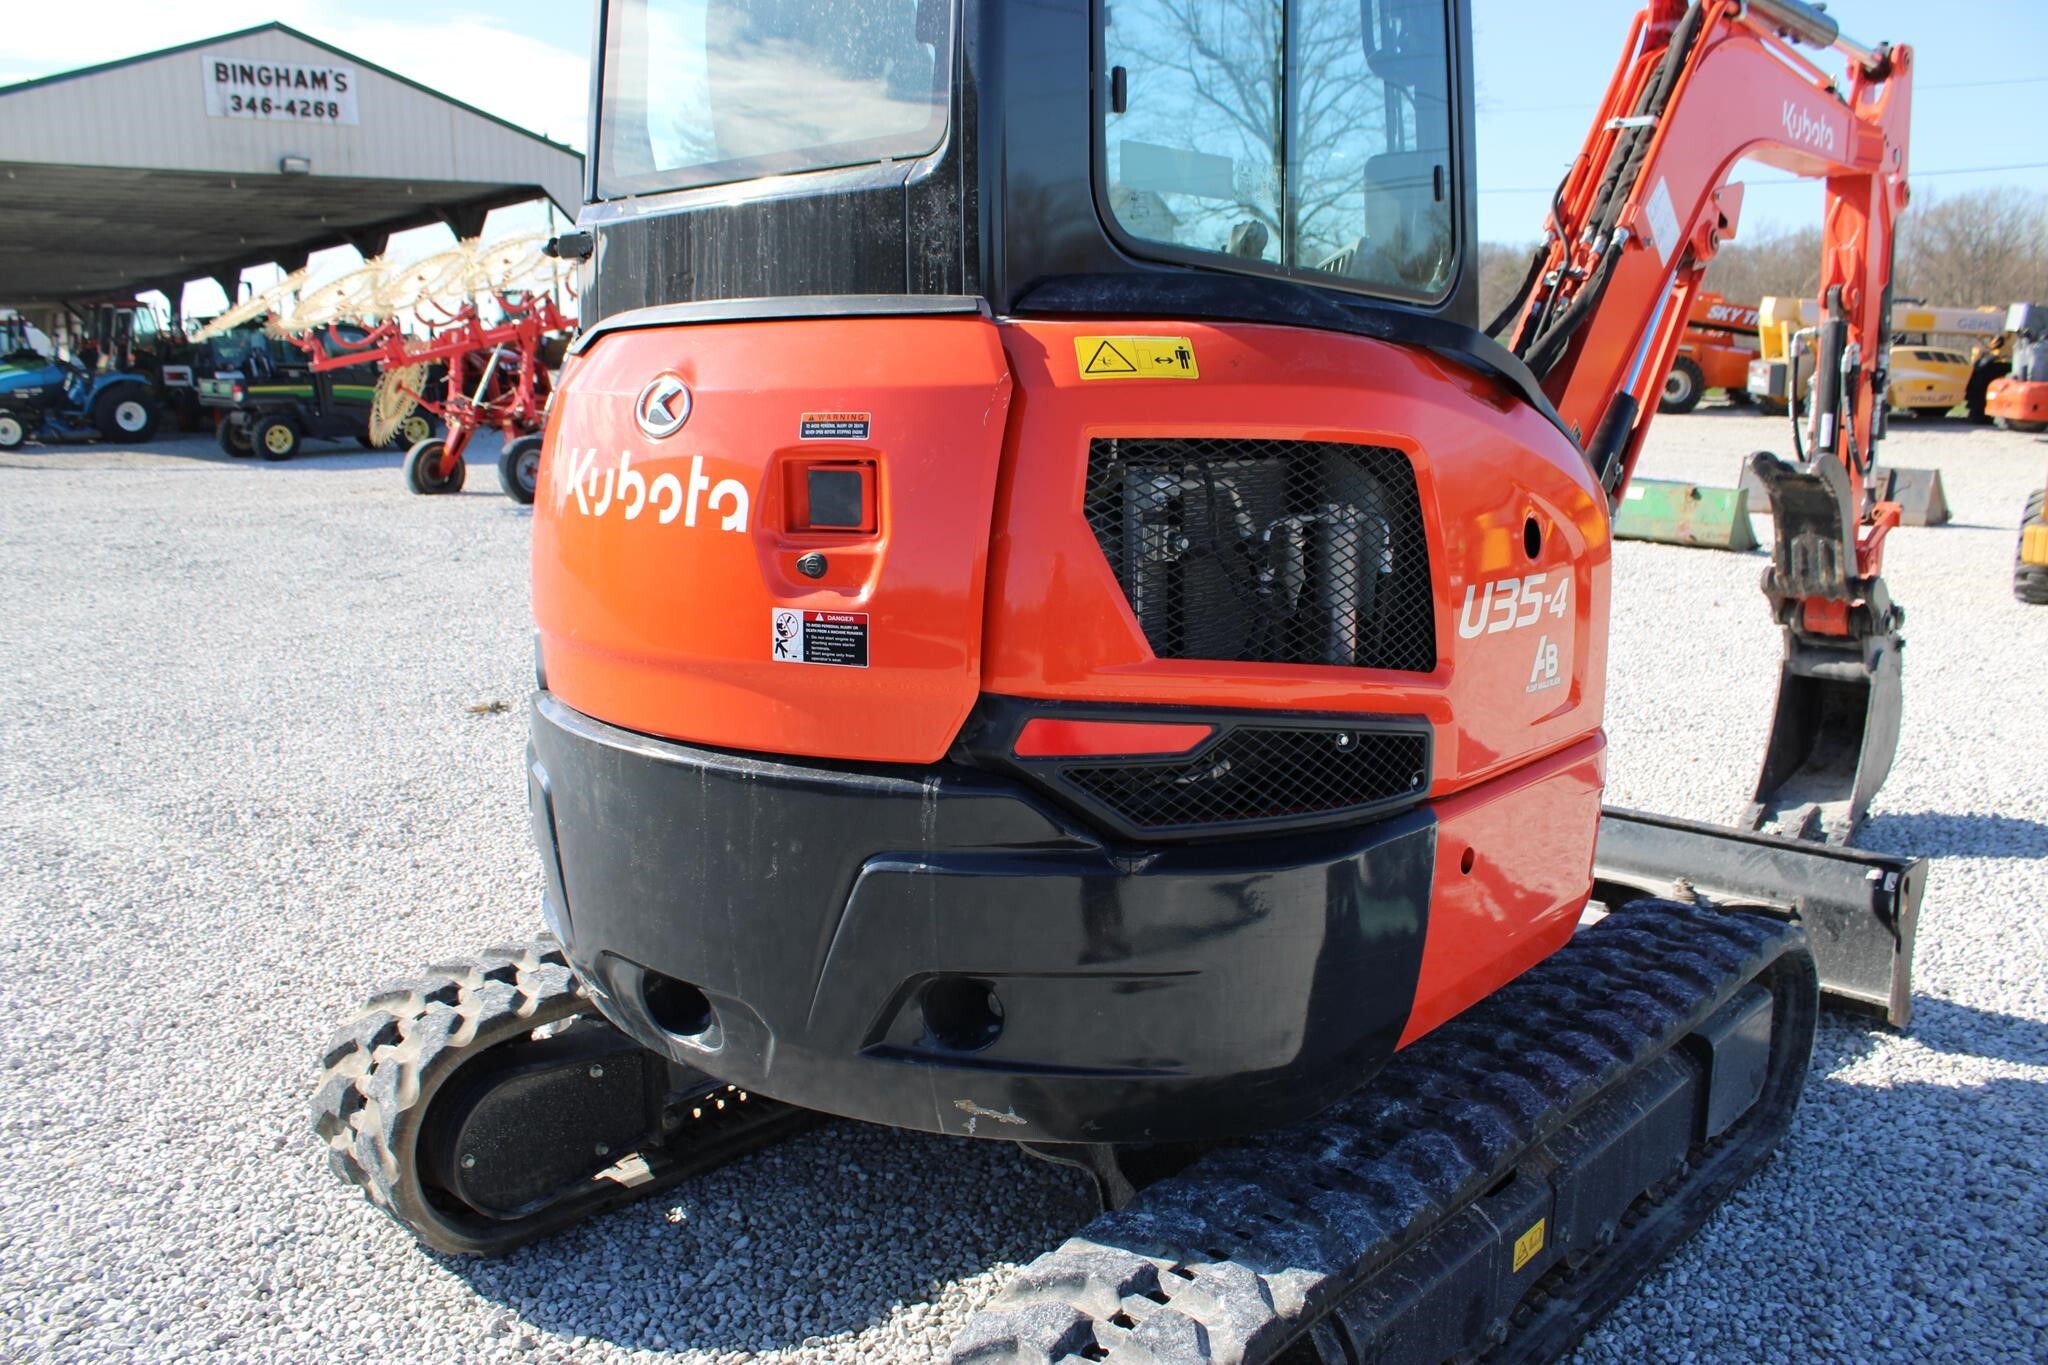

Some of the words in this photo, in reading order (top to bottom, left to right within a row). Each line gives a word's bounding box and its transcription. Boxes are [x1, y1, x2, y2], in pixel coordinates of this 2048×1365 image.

[215, 62, 348, 92] BINGHAM'S
[230, 94, 340, 118] 346-4268
[1782, 100, 1834, 150] Kubota
[1707, 304, 1743, 323] SKY
[566, 447, 750, 533] Kubota
[1458, 573, 1569, 639] U35-4
[1530, 634, 1558, 682] AB
